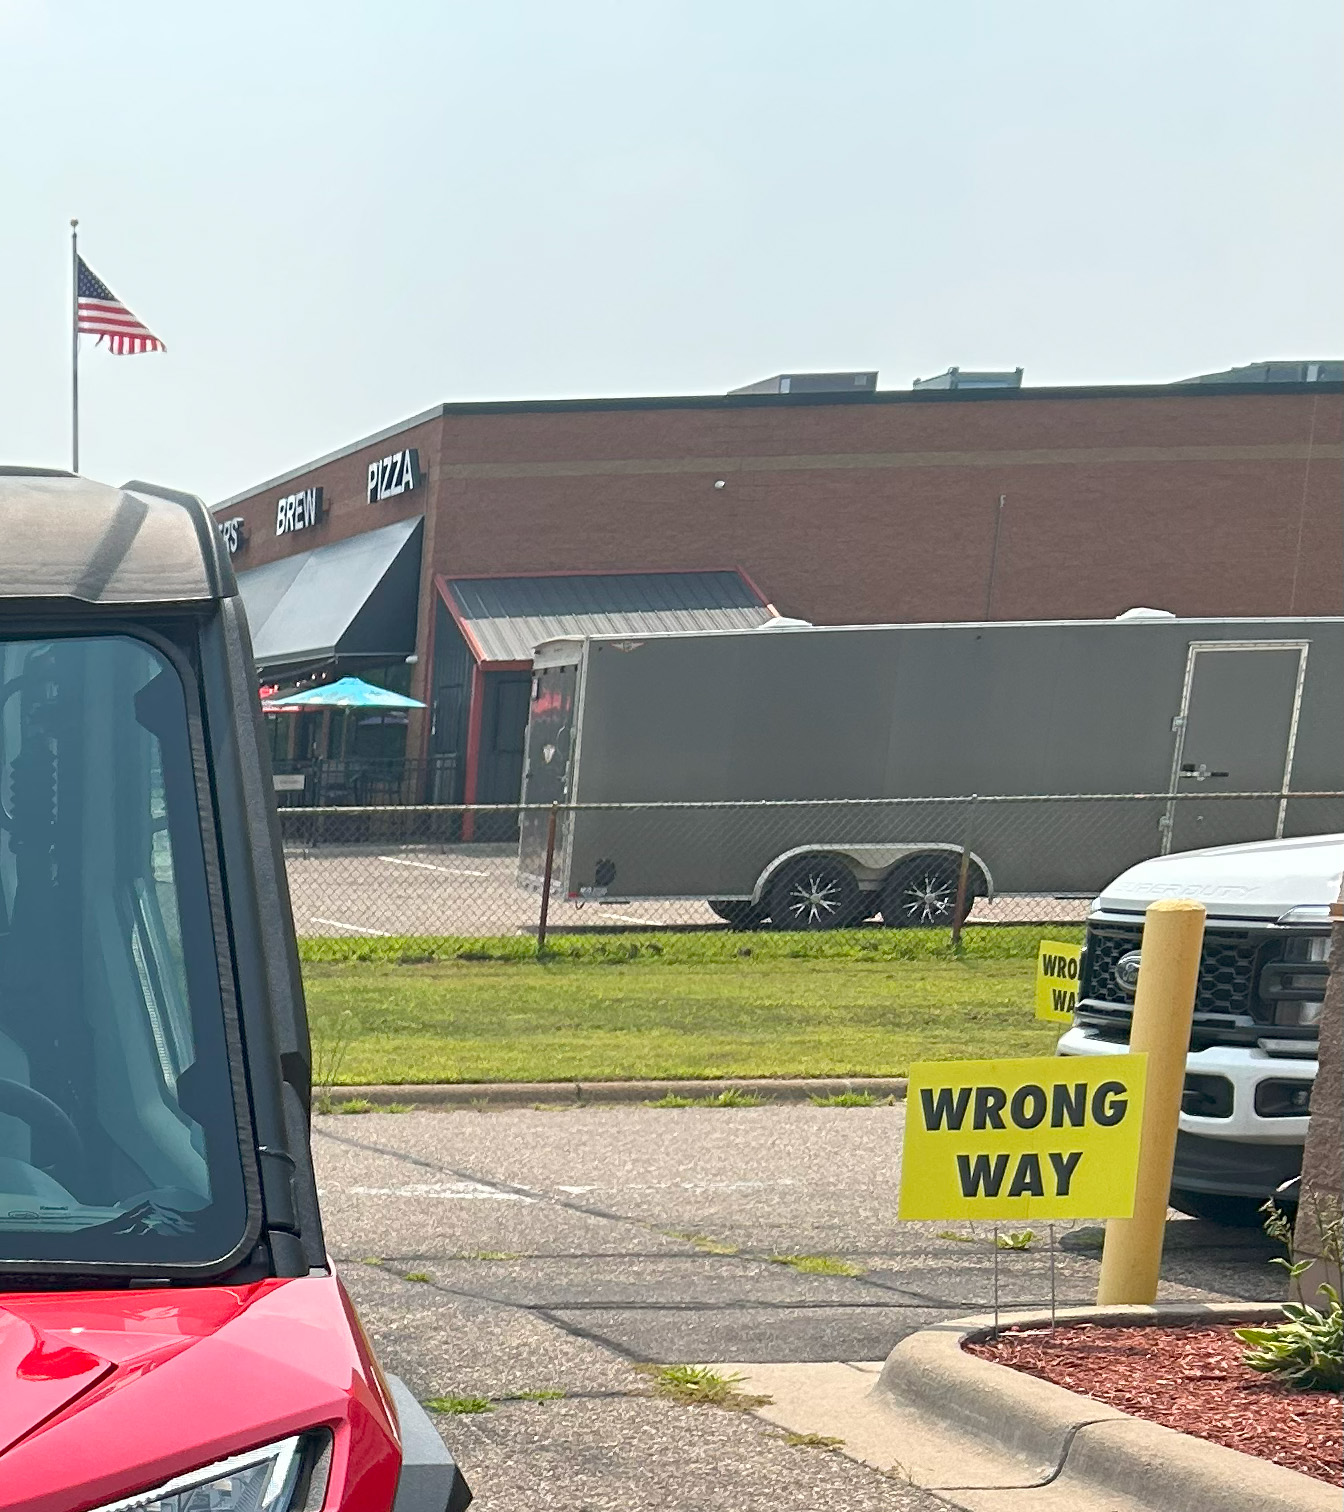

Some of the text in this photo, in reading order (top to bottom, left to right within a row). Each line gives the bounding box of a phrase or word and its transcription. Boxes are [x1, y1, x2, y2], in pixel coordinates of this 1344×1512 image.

[276, 487, 318, 536] BREW
[367, 449, 415, 505] PIZZA
[1043, 954, 1082, 980] WRO
[1053, 989, 1075, 1012] WA
[920, 1081, 1128, 1131] WRONG
[957, 1152, 1083, 1197] WAY
